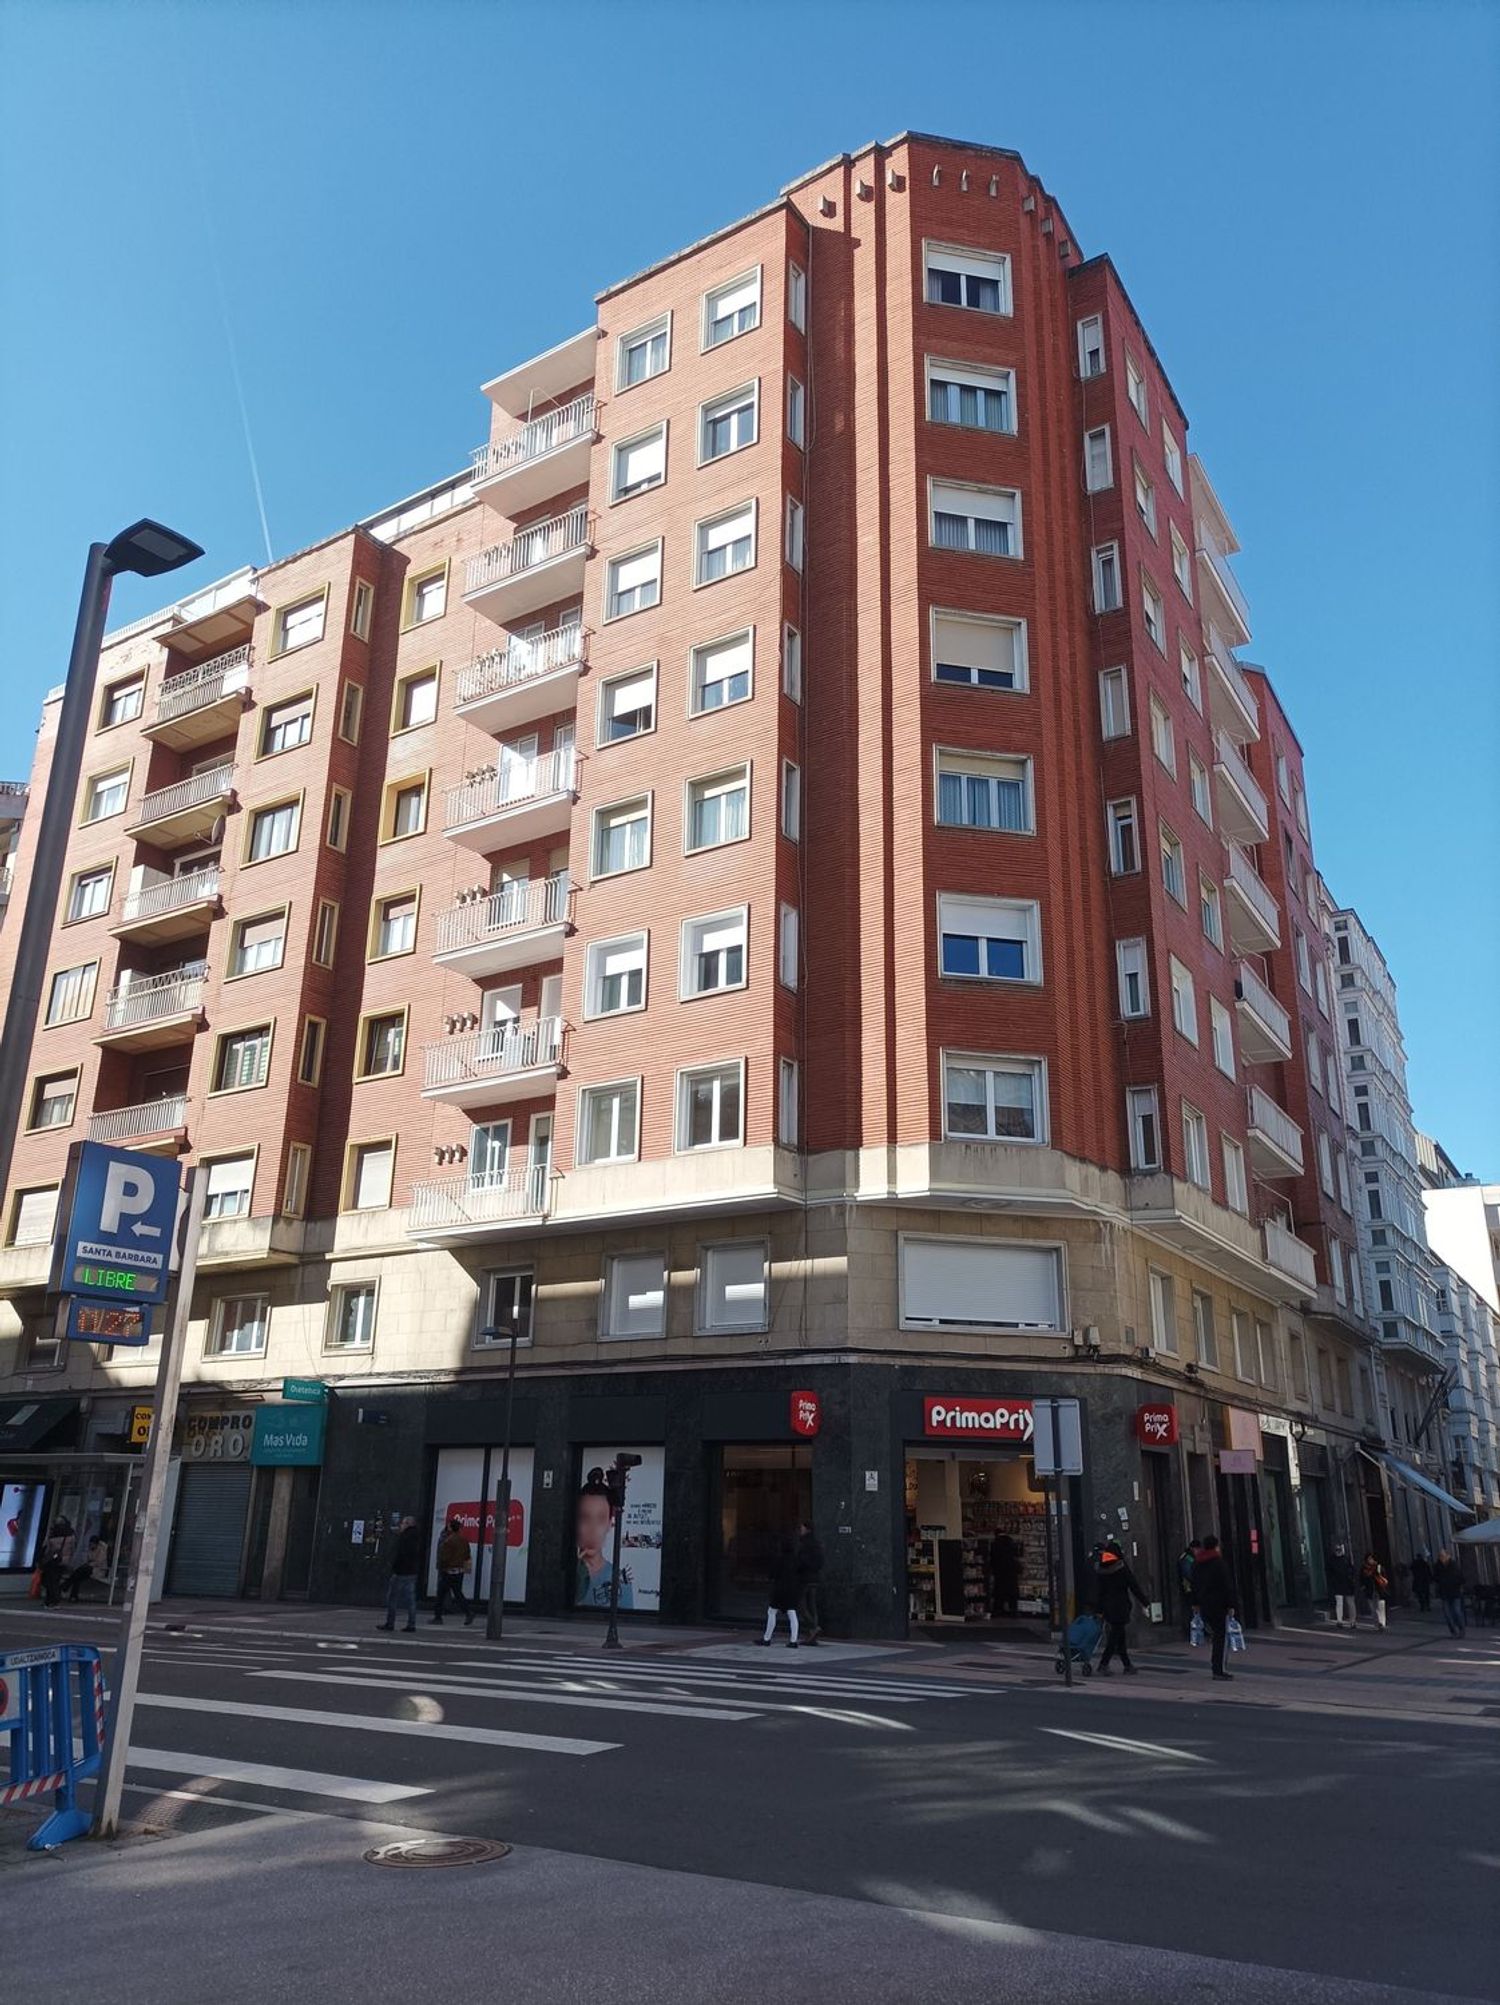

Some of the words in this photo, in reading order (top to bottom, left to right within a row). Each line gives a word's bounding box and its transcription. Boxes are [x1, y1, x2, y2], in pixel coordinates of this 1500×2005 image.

[99, 1160, 156, 1234] P
[81, 1245, 114, 1260] SANTA
[114, 1249, 159, 1266] BARBARA
[84, 1268, 137, 1291] LIBRE
[188, 1414, 253, 1430] COMPRO
[191, 1431, 245, 1458] ORO
[263, 1432, 284, 1447] Mas
[285, 1432, 308, 1447] Vida
